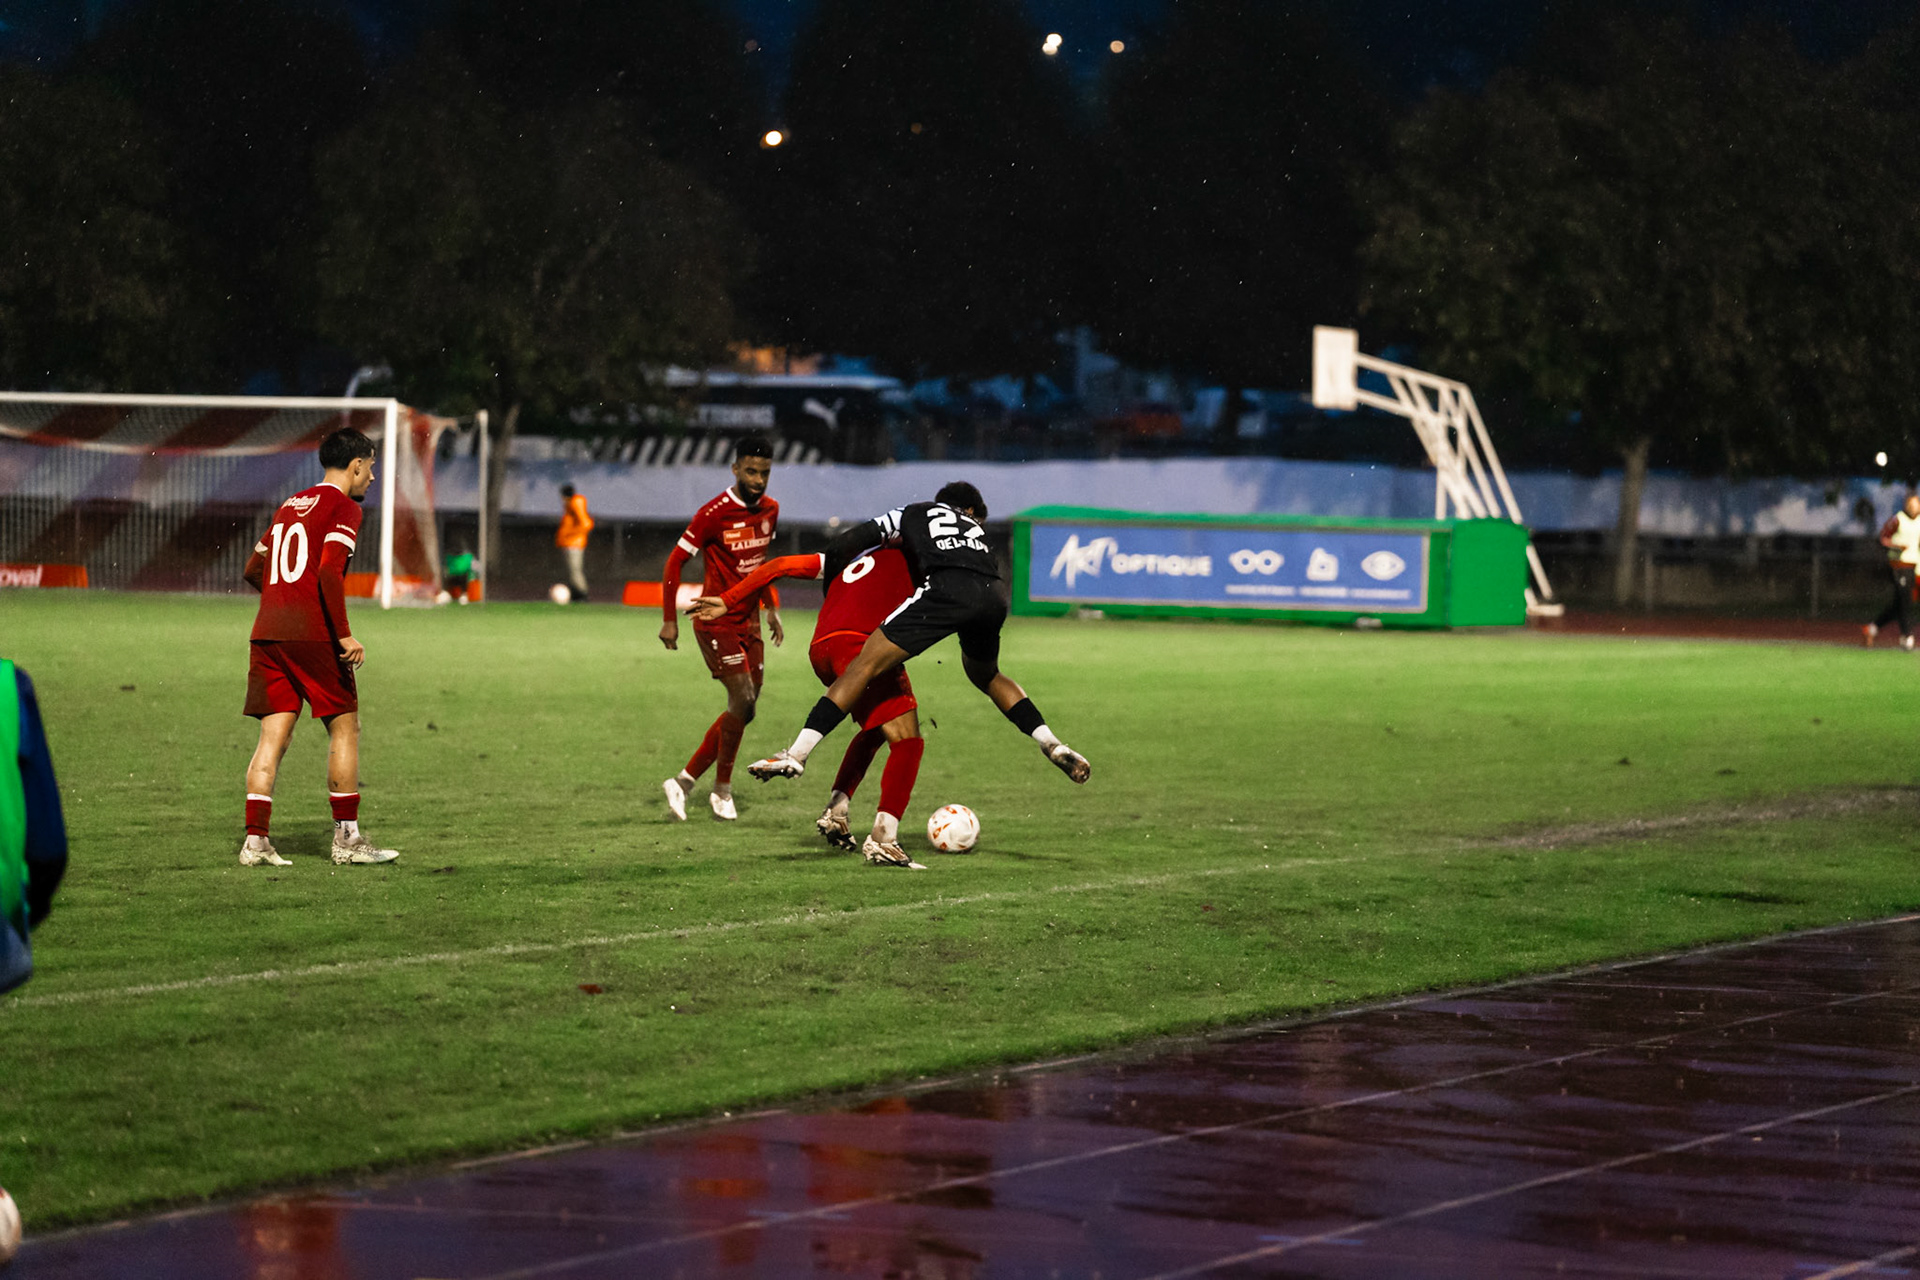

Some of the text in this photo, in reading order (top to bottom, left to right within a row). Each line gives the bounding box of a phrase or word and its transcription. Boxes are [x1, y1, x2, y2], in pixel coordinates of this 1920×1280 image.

[927, 507, 985, 539] 27
[269, 522, 309, 585] 10
[1111, 554, 1212, 576] OPTIQUE
[842, 555, 875, 584] 6
